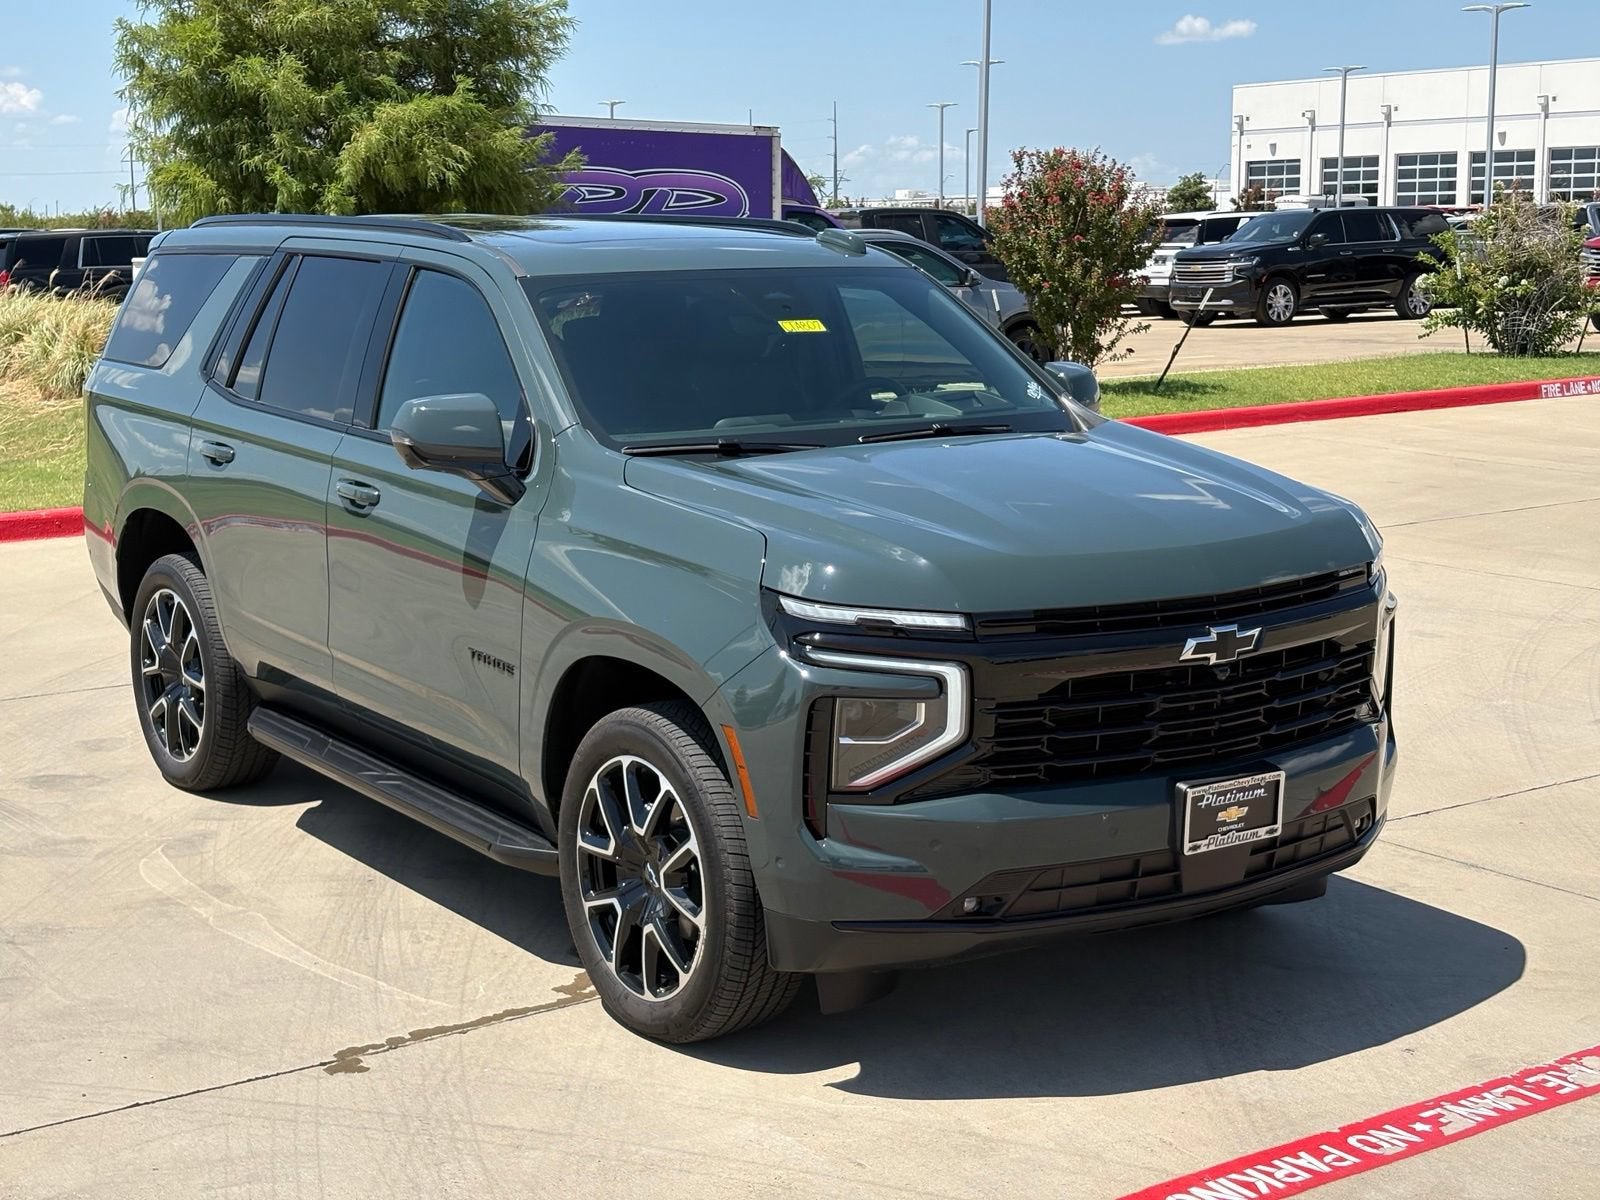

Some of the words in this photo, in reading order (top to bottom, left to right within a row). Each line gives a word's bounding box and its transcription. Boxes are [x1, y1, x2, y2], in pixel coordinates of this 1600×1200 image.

[1541, 383, 1562, 398] FIRE
[1563, 381, 1587, 396] LANE
[1197, 788, 1268, 808] Platinum
[1217, 823, 1245, 833] CHEVROLET
[1203, 830, 1262, 849] Platinum
[1346, 1125, 1424, 1155] NO
[1165, 1145, 1362, 1200] PARKIN
